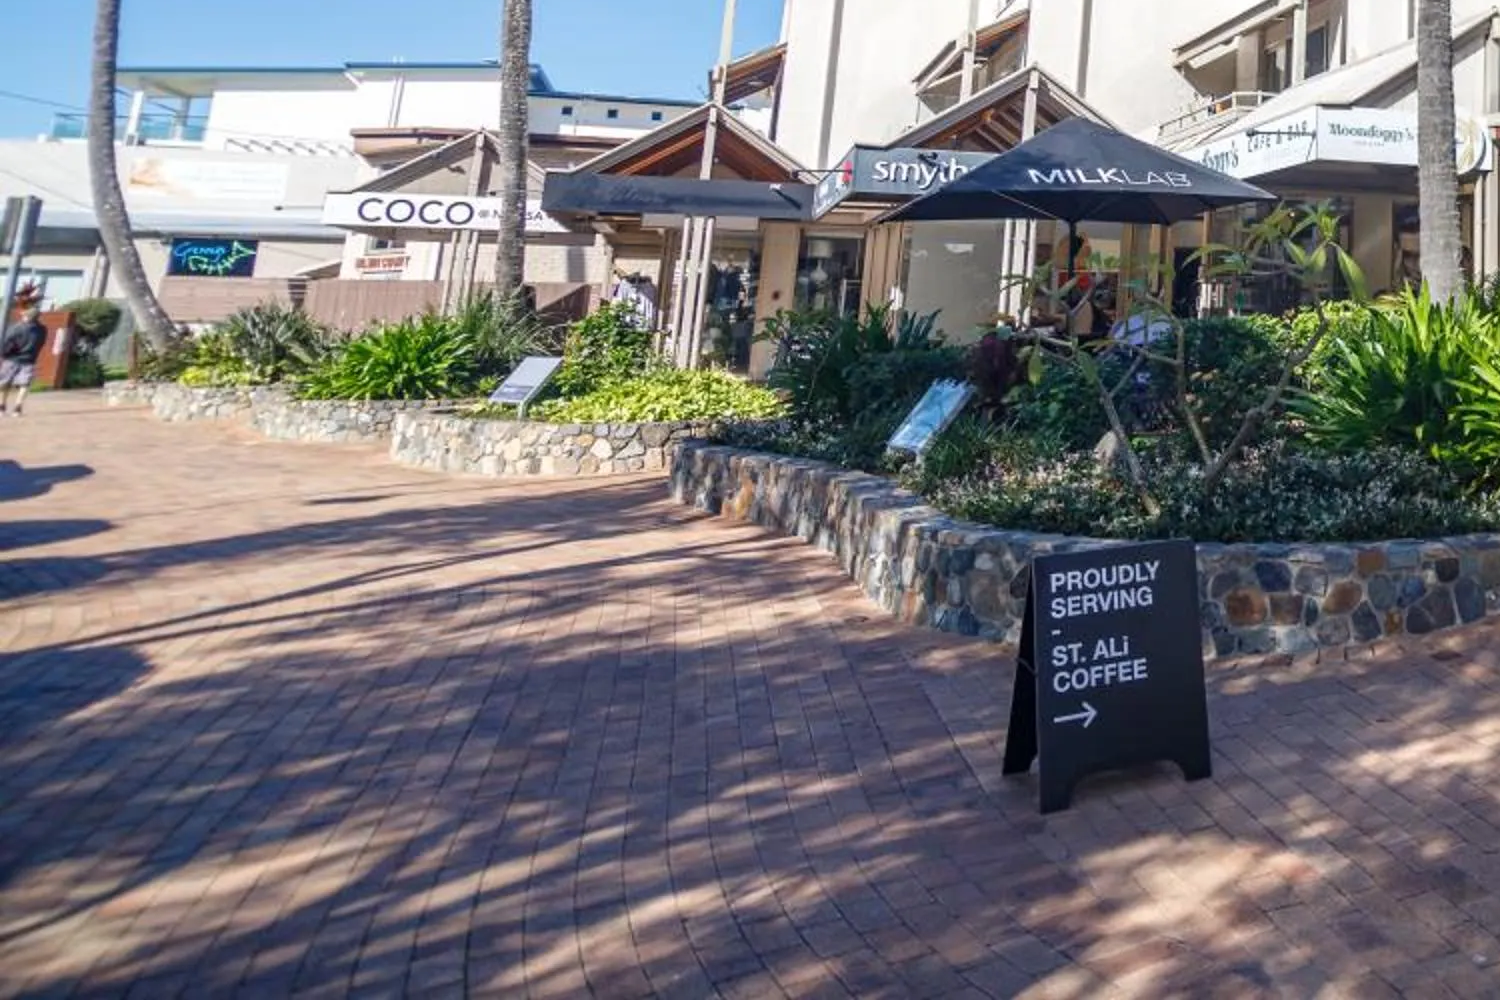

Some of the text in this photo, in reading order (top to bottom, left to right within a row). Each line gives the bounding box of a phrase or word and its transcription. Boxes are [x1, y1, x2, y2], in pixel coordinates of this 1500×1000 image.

[1028, 167, 1192, 187] MILKLAB
[358, 198, 474, 225] COCO
[1051, 560, 1160, 593] PROUDLY
[1051, 587, 1153, 619] SERVING
[1052, 642, 1086, 666] ST.
[1053, 658, 1148, 692] COFFEE
